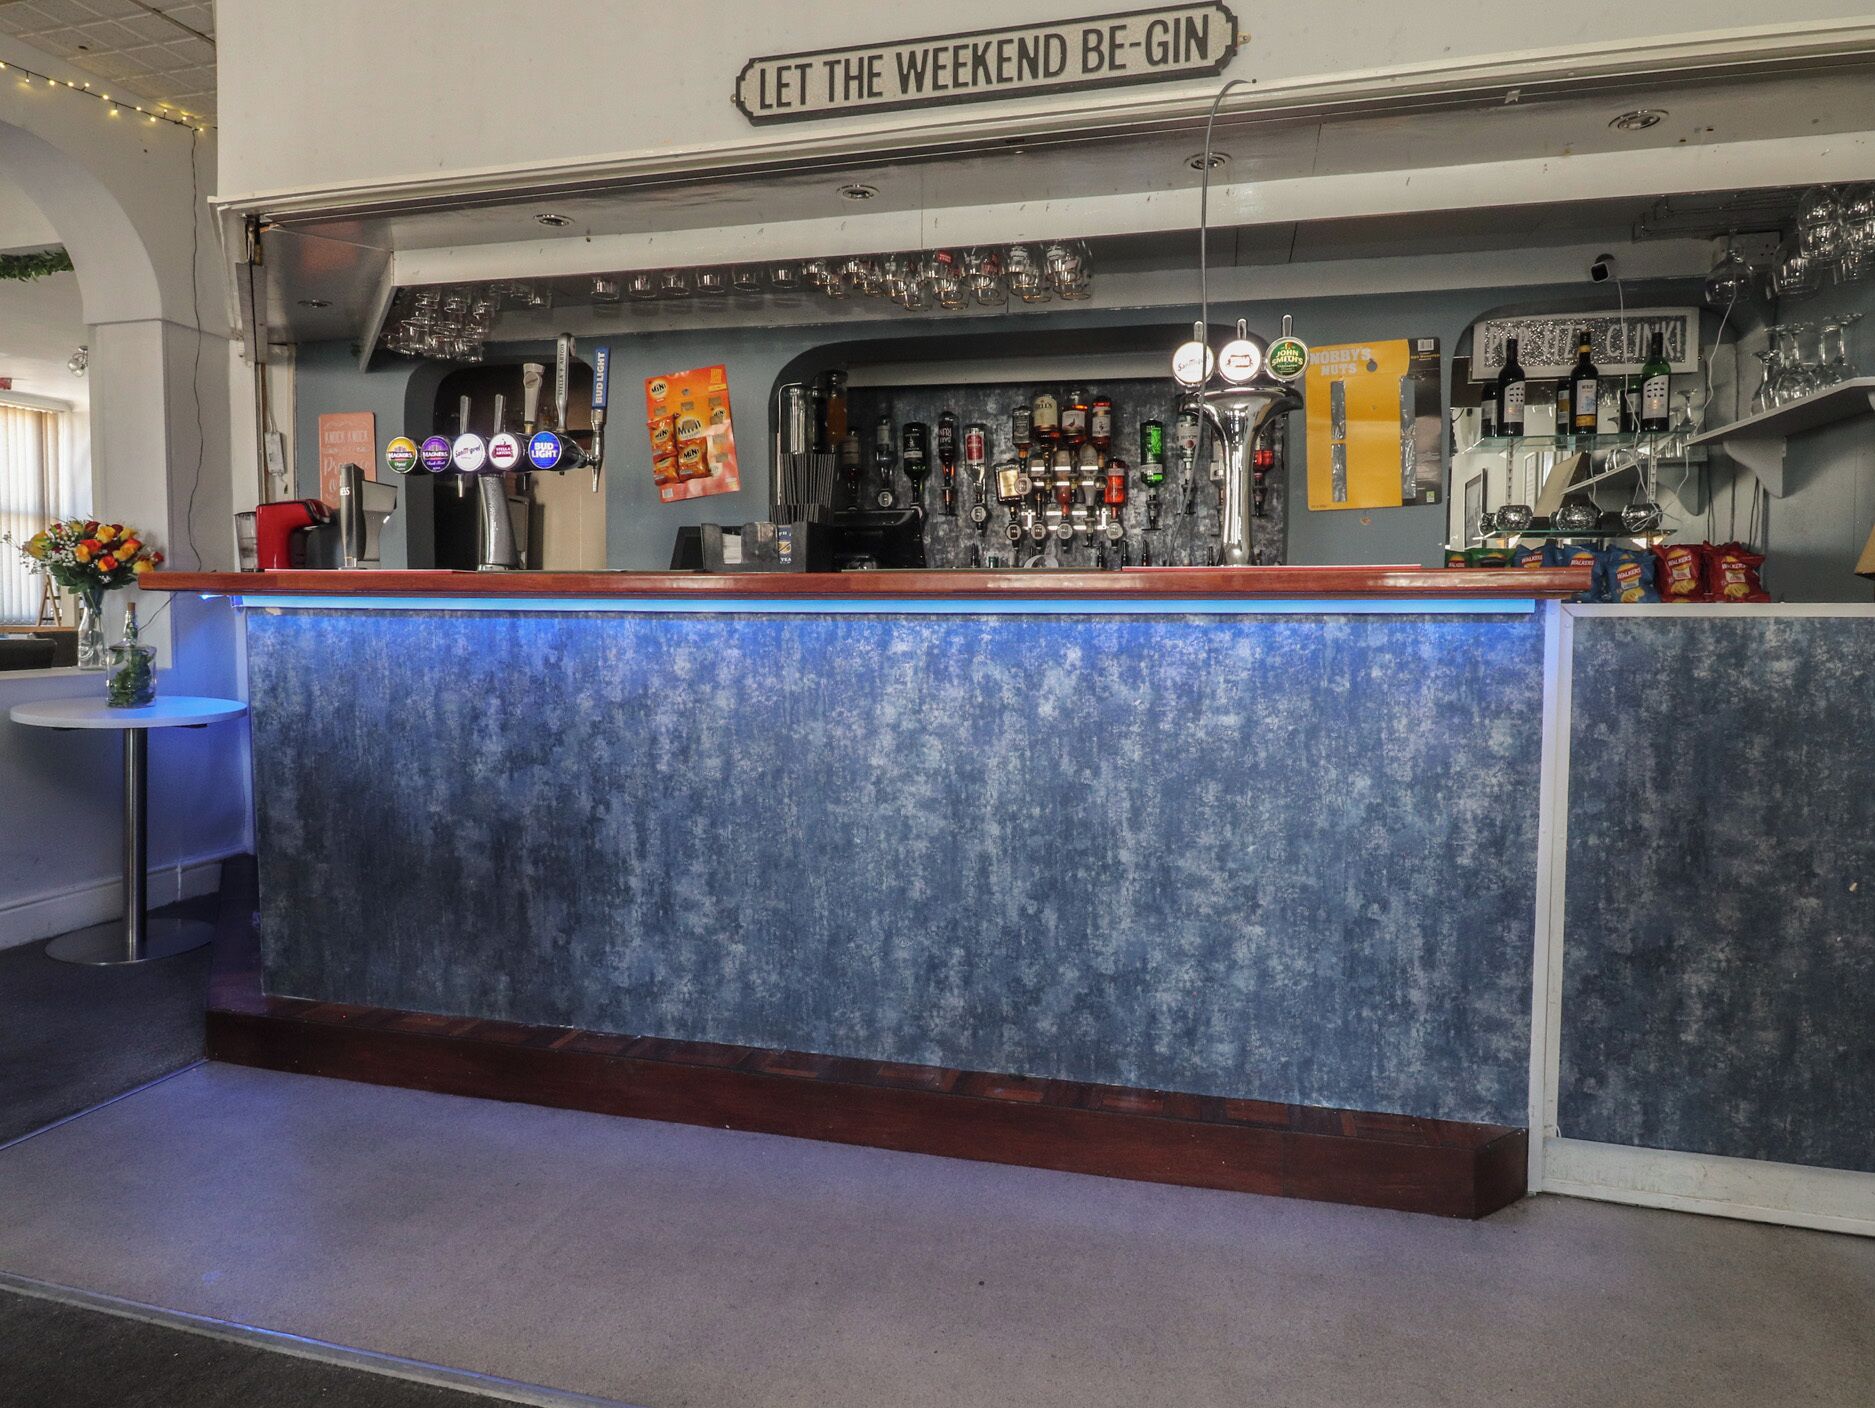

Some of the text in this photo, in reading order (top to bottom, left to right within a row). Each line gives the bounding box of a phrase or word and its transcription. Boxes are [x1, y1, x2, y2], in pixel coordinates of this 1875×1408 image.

[758, 13, 1210, 110] LET THE WEEKEND BE-GIN
[1276, 349, 1299, 358] JOHN
[1271, 355, 1304, 367] SMITH'S
[1320, 362, 1359, 376] NUTS
[595, 352, 605, 404] BUD LIGHT
[534, 442, 554, 450] BUD
[531, 450, 558, 459] LIGHT
[1521, 553, 1544, 564] WALKERS
[1570, 559, 1595, 567] WALKERS
[1667, 555, 1692, 567] WALKERS
[1616, 567, 1642, 580] WALKERS
